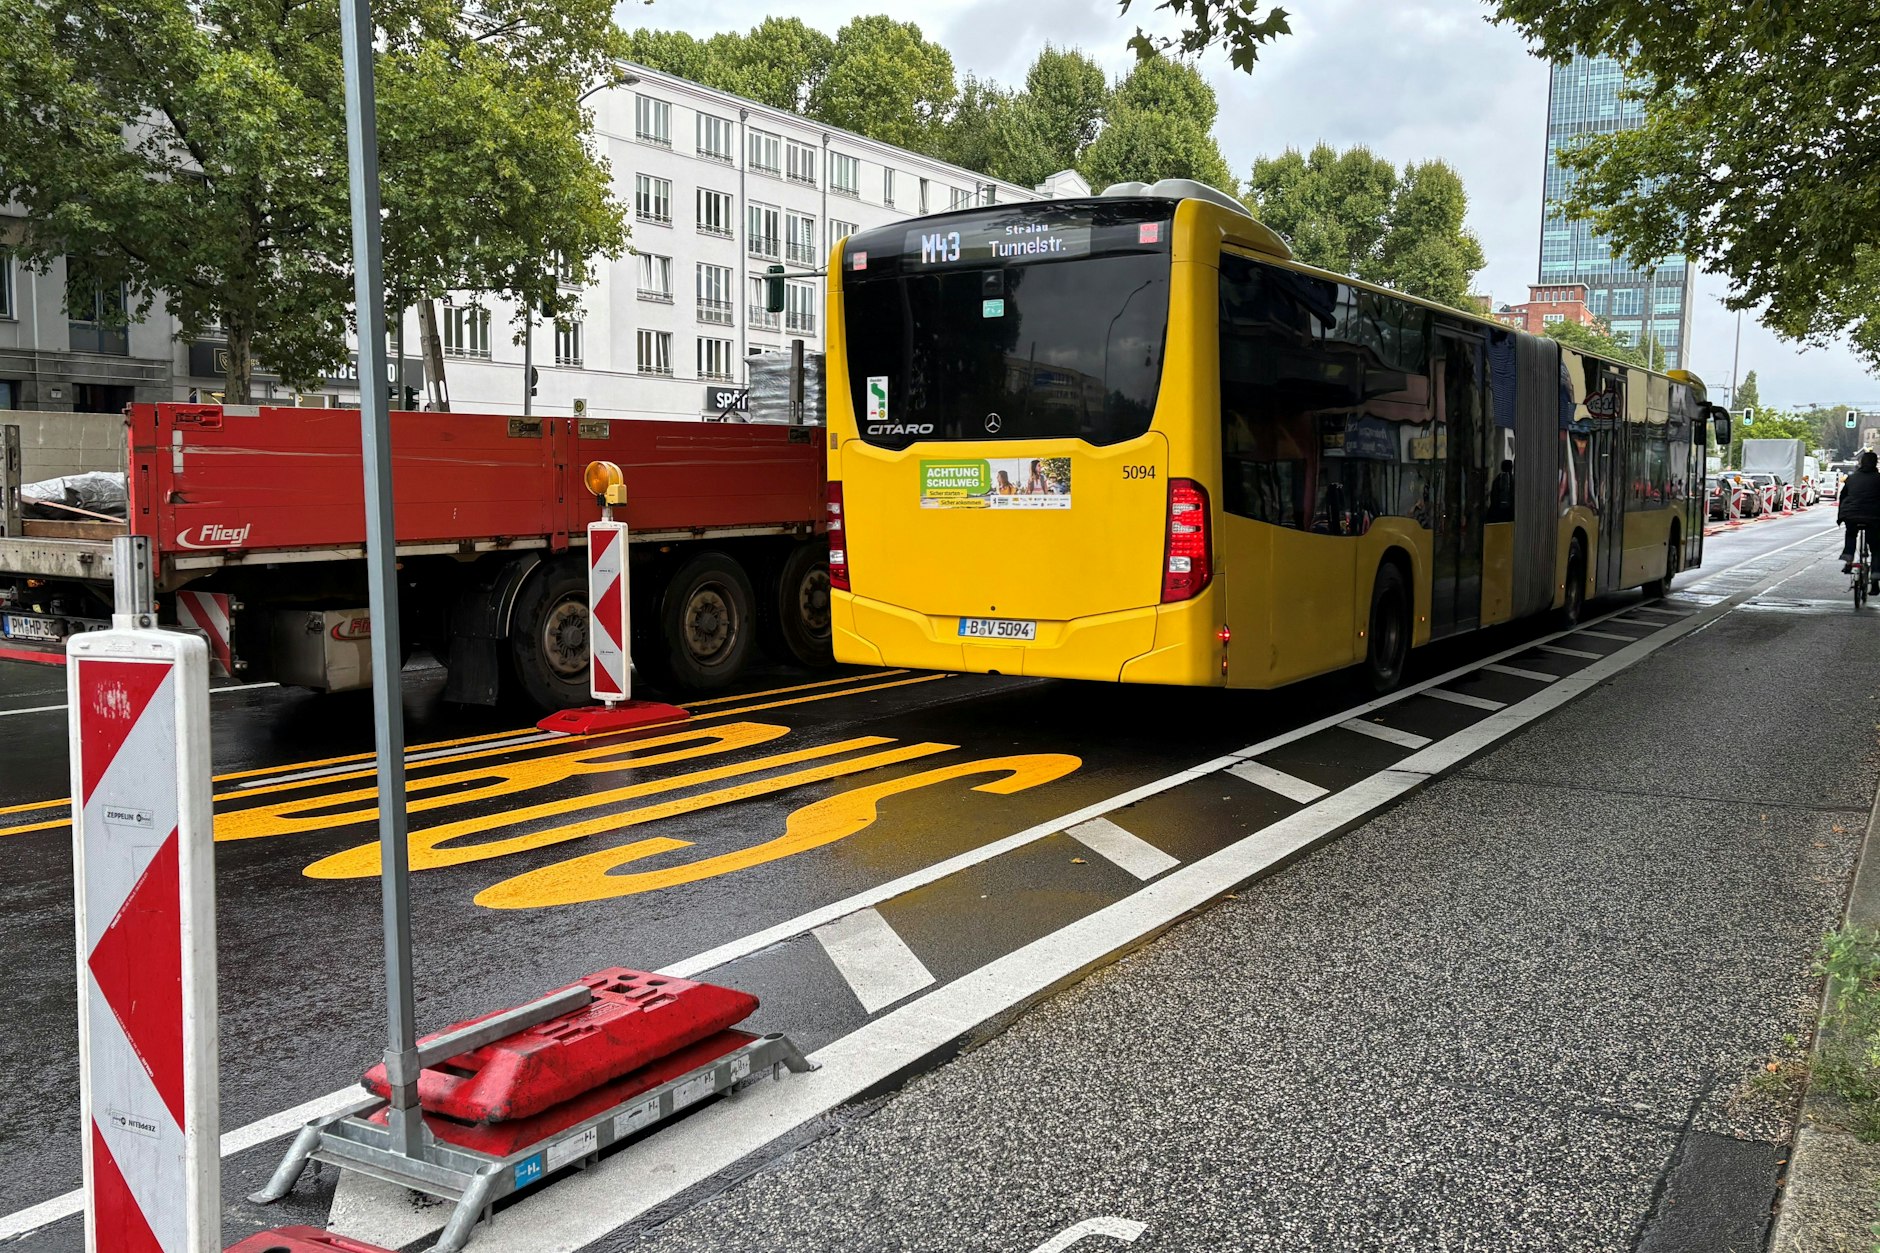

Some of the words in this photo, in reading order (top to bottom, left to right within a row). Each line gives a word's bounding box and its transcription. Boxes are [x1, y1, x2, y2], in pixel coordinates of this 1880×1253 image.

[1005, 224, 1049, 236] Stralau
[921, 231, 960, 264] M43
[988, 235, 1067, 259] Tunnelstr.
[867, 424, 934, 435] CITARO
[927, 468, 979, 477] ACHTUNG
[1122, 465, 1156, 480] 5094
[926, 479, 979, 487] SCHULWEG
[199, 523, 251, 544] Fliegl
[997, 622, 1030, 637] 5094
[107, 811, 134, 820] ZEPPELIN
[213, 721, 1083, 909] BUS
[128, 1119, 156, 1132] ZEPPELIN
